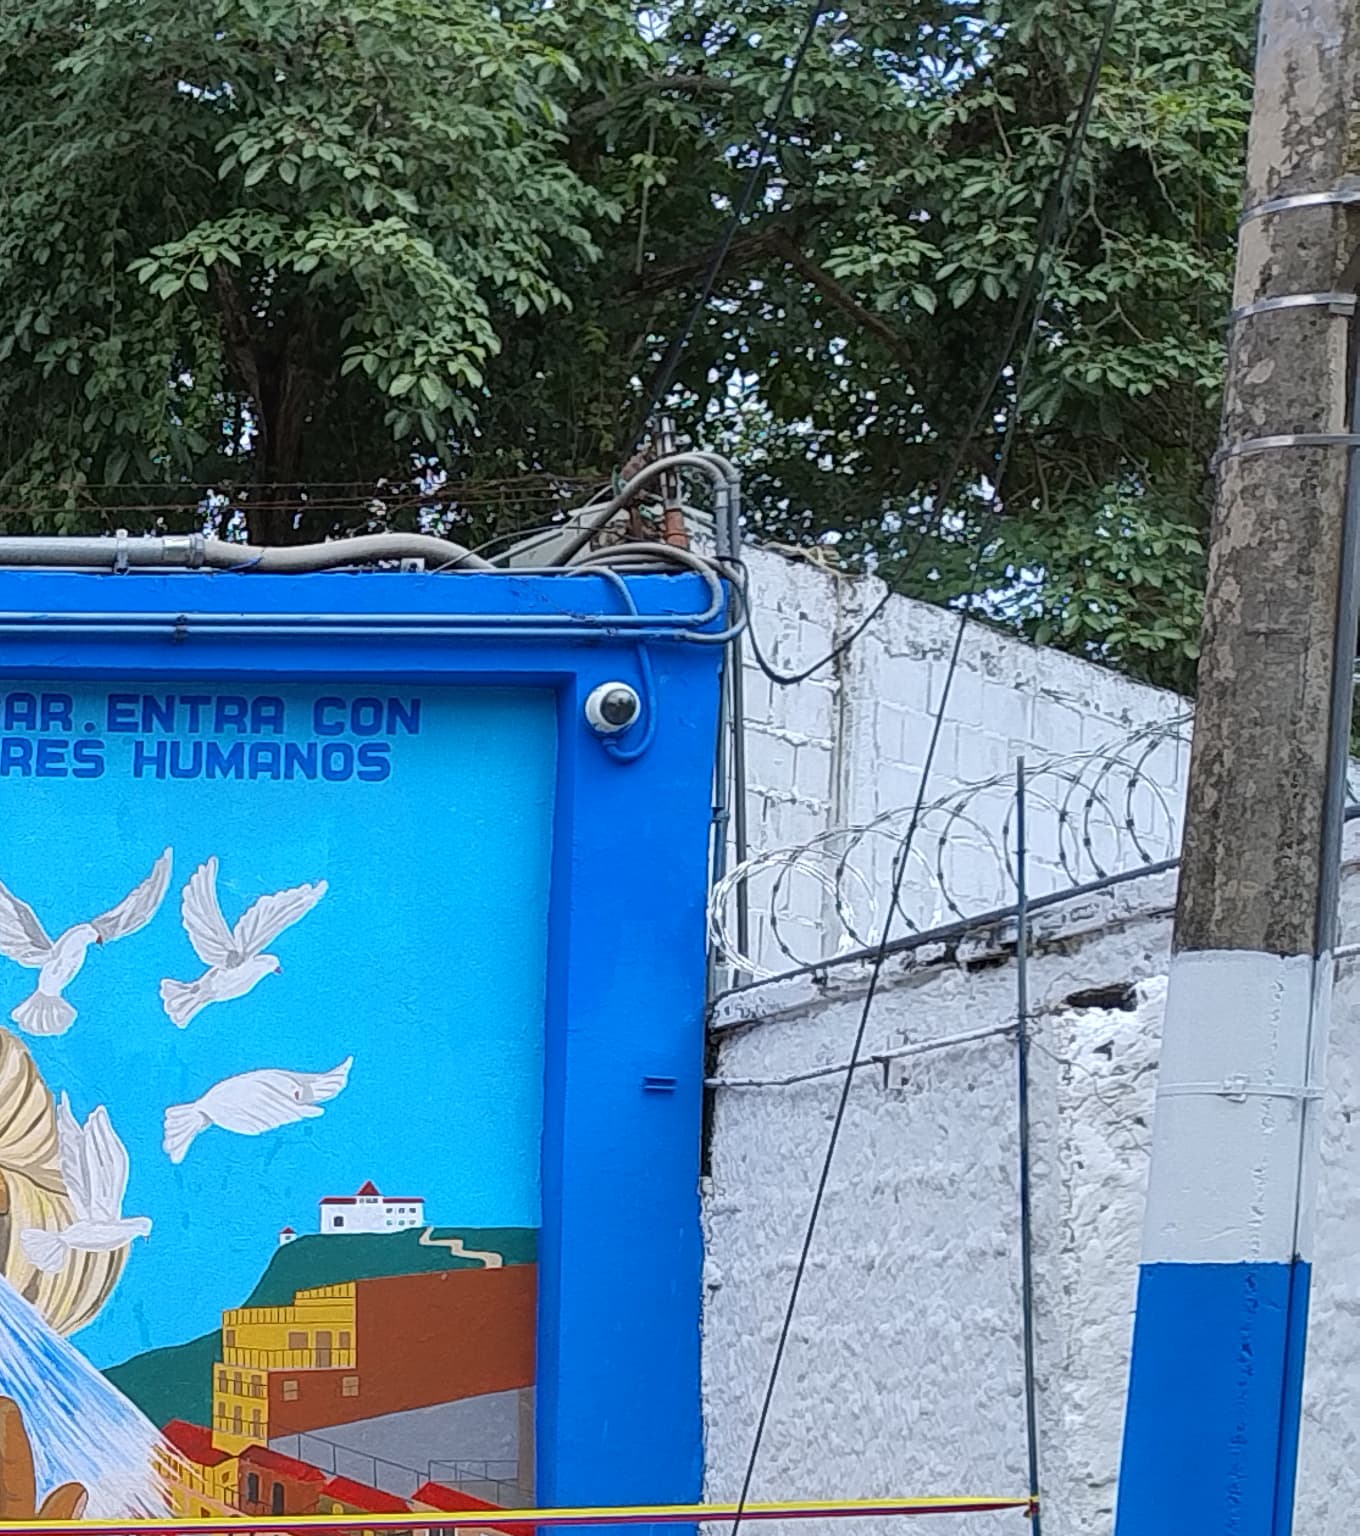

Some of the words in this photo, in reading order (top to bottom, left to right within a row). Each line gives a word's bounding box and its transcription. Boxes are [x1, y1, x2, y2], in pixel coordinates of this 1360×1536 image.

[106, 694, 285, 735] ENTRA
[312, 697, 421, 736] CON
[133, 741, 391, 782] HUMANOS
